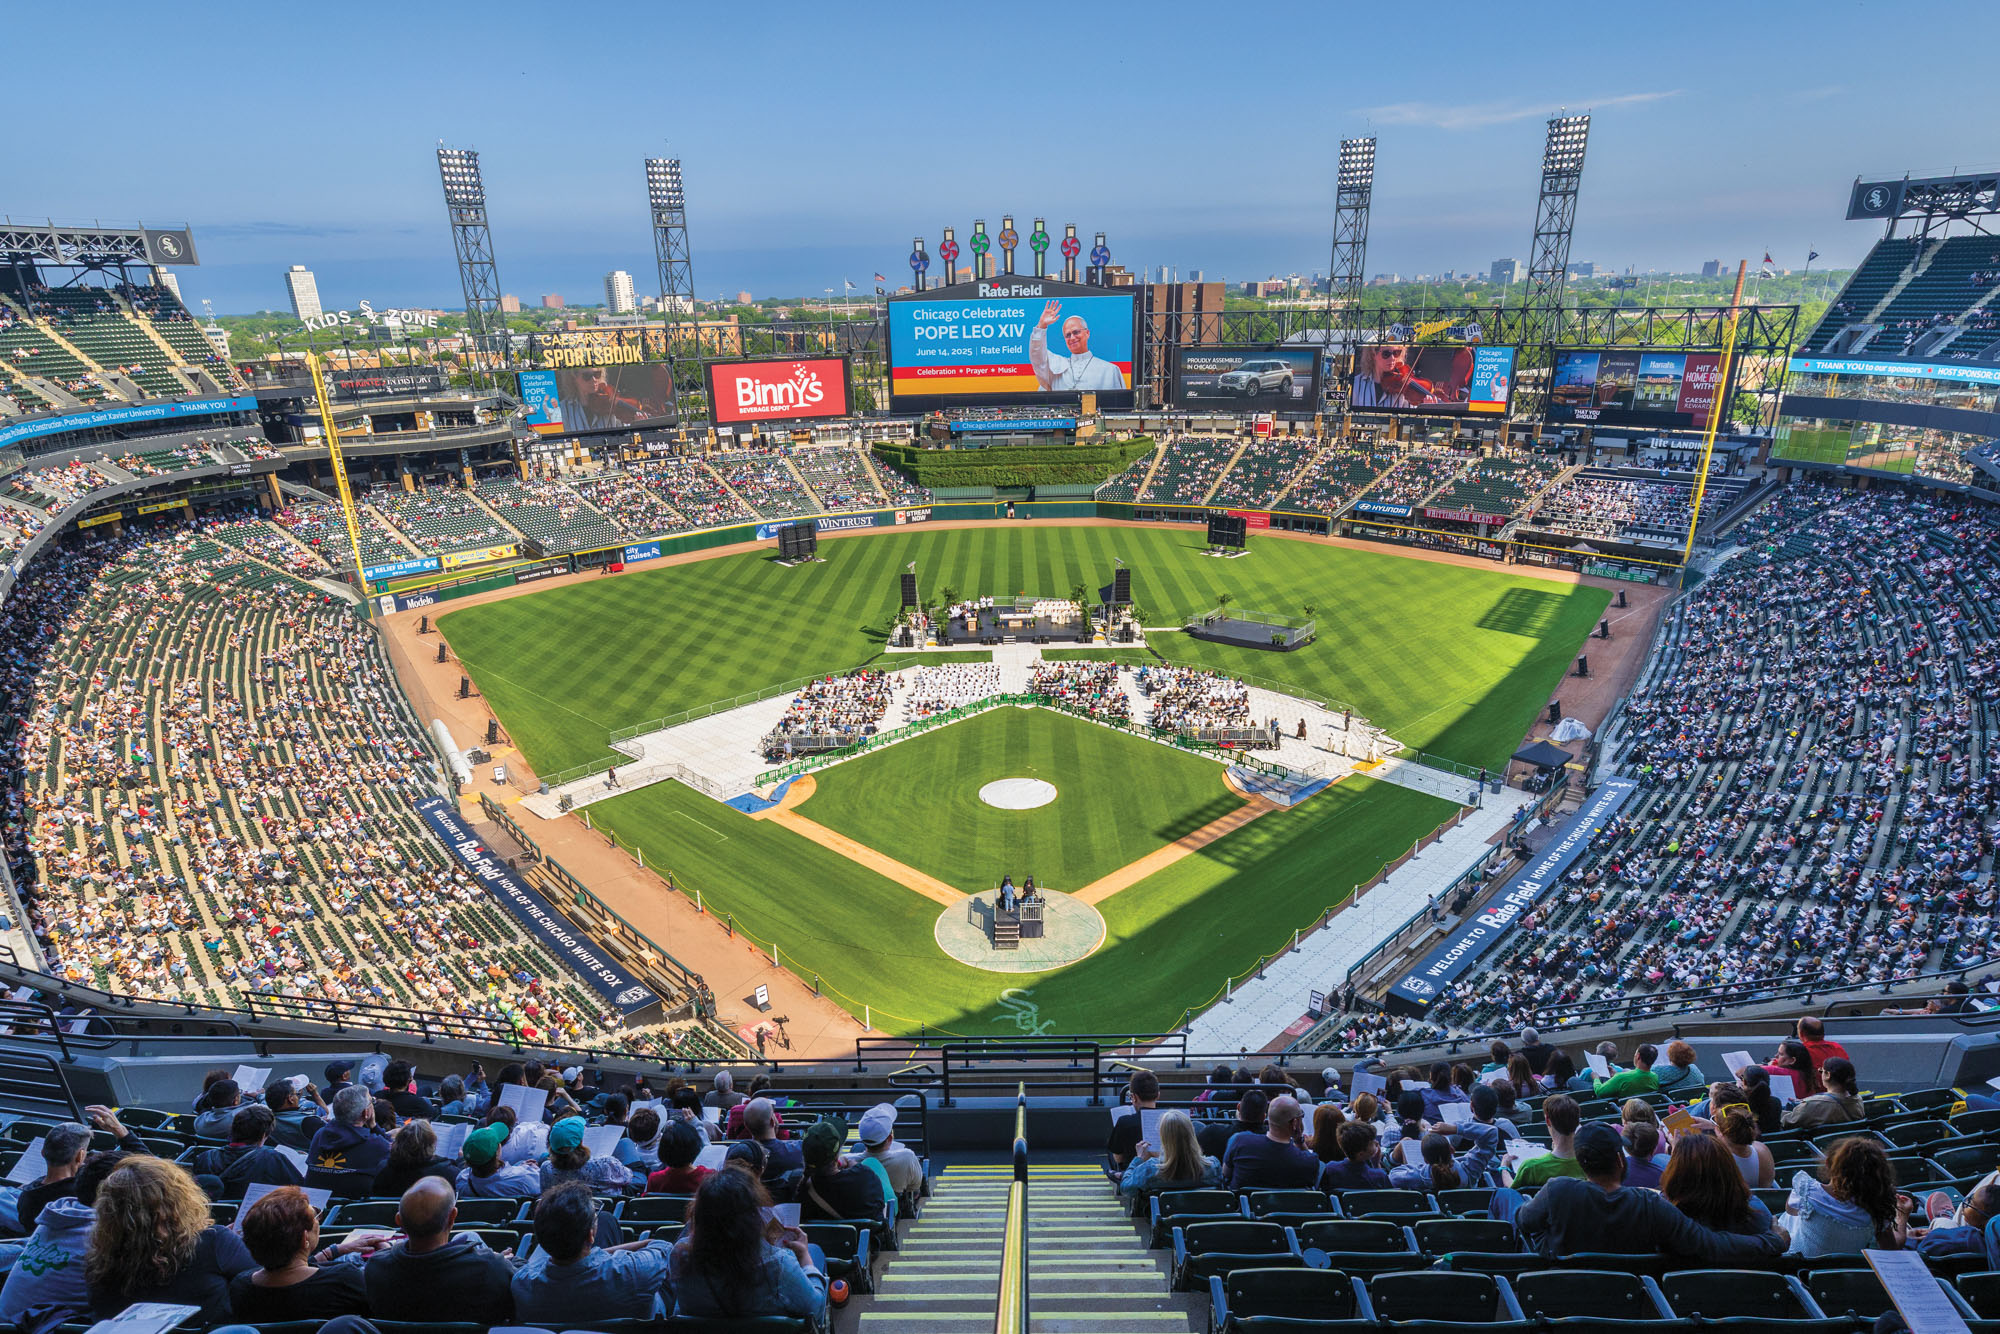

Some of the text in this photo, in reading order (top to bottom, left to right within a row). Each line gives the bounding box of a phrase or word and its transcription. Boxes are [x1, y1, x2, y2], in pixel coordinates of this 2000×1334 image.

[979, 283, 1042, 297] Rate Field
[388, 309, 438, 328] ZONE
[913, 307, 1025, 322] Chicago Celebrates
[304, 310, 351, 333] KIDS
[915, 323, 1025, 340] POPE LEO XIV
[1414, 318, 1457, 340] Miller
[1446, 327, 1465, 336] TIME
[541, 332, 602, 347] CAESARS
[916, 345, 1023, 357] June 14, 2025 Rate Field
[543, 345, 644, 369] SPORTSBOOK
[917, 368, 956, 376] Celebration
[966, 367, 988, 375] Prayer
[1477, 364, 1499, 372] POPE
[1696, 364, 1719, 373] HIT A
[1816, 361, 1844, 370] THANK
[1846, 362, 1865, 371] YOU
[1888, 365, 1923, 374] sponsors
[1937, 367, 1957, 376] HOST
[1957, 368, 1993, 378] SPONSOR:
[522, 374, 545, 382] Chicago
[1686, 371, 1708, 383] HOME
[524, 388, 546, 396] POPE
[526, 396, 542, 404] LEO
[181, 401, 227, 412] THANK YOU
[739, 406, 769, 414] BEVERAGE
[64, 416, 92, 427] Pushpay,
[92, 412, 109, 423] Saint
[108, 410, 129, 420] Xavier
[129, 407, 165, 418] University
[962, 422, 986, 430] Chicago
[987, 421, 1020, 429] Celebrates
[1020, 420, 1038, 428] POPE
[646, 441, 669, 451] Modelo
[1650, 438, 1669, 449] Lite
[906, 508, 931, 517] STREAM
[1372, 505, 1408, 514] HYUNDAI
[818, 516, 874, 529] WINTRUST
[1471, 514, 1493, 524] MEATS
[626, 547, 638, 556] city
[1478, 542, 1502, 555] Rate
[454, 551, 475, 560] Vienna
[375, 565, 396, 573] RELIEF
[404, 561, 421, 569] HERE
[1596, 570, 1617, 578] RUSH
[407, 595, 434, 610] Modelo
[1427, 790, 1618, 976] WELCOME TO Rate Field HOME OF THE CHICAGO WHITE SOX
[433, 809, 624, 987] WELCOME TO Rate Field HOME OF THE CHICAGO WHITE SOX
